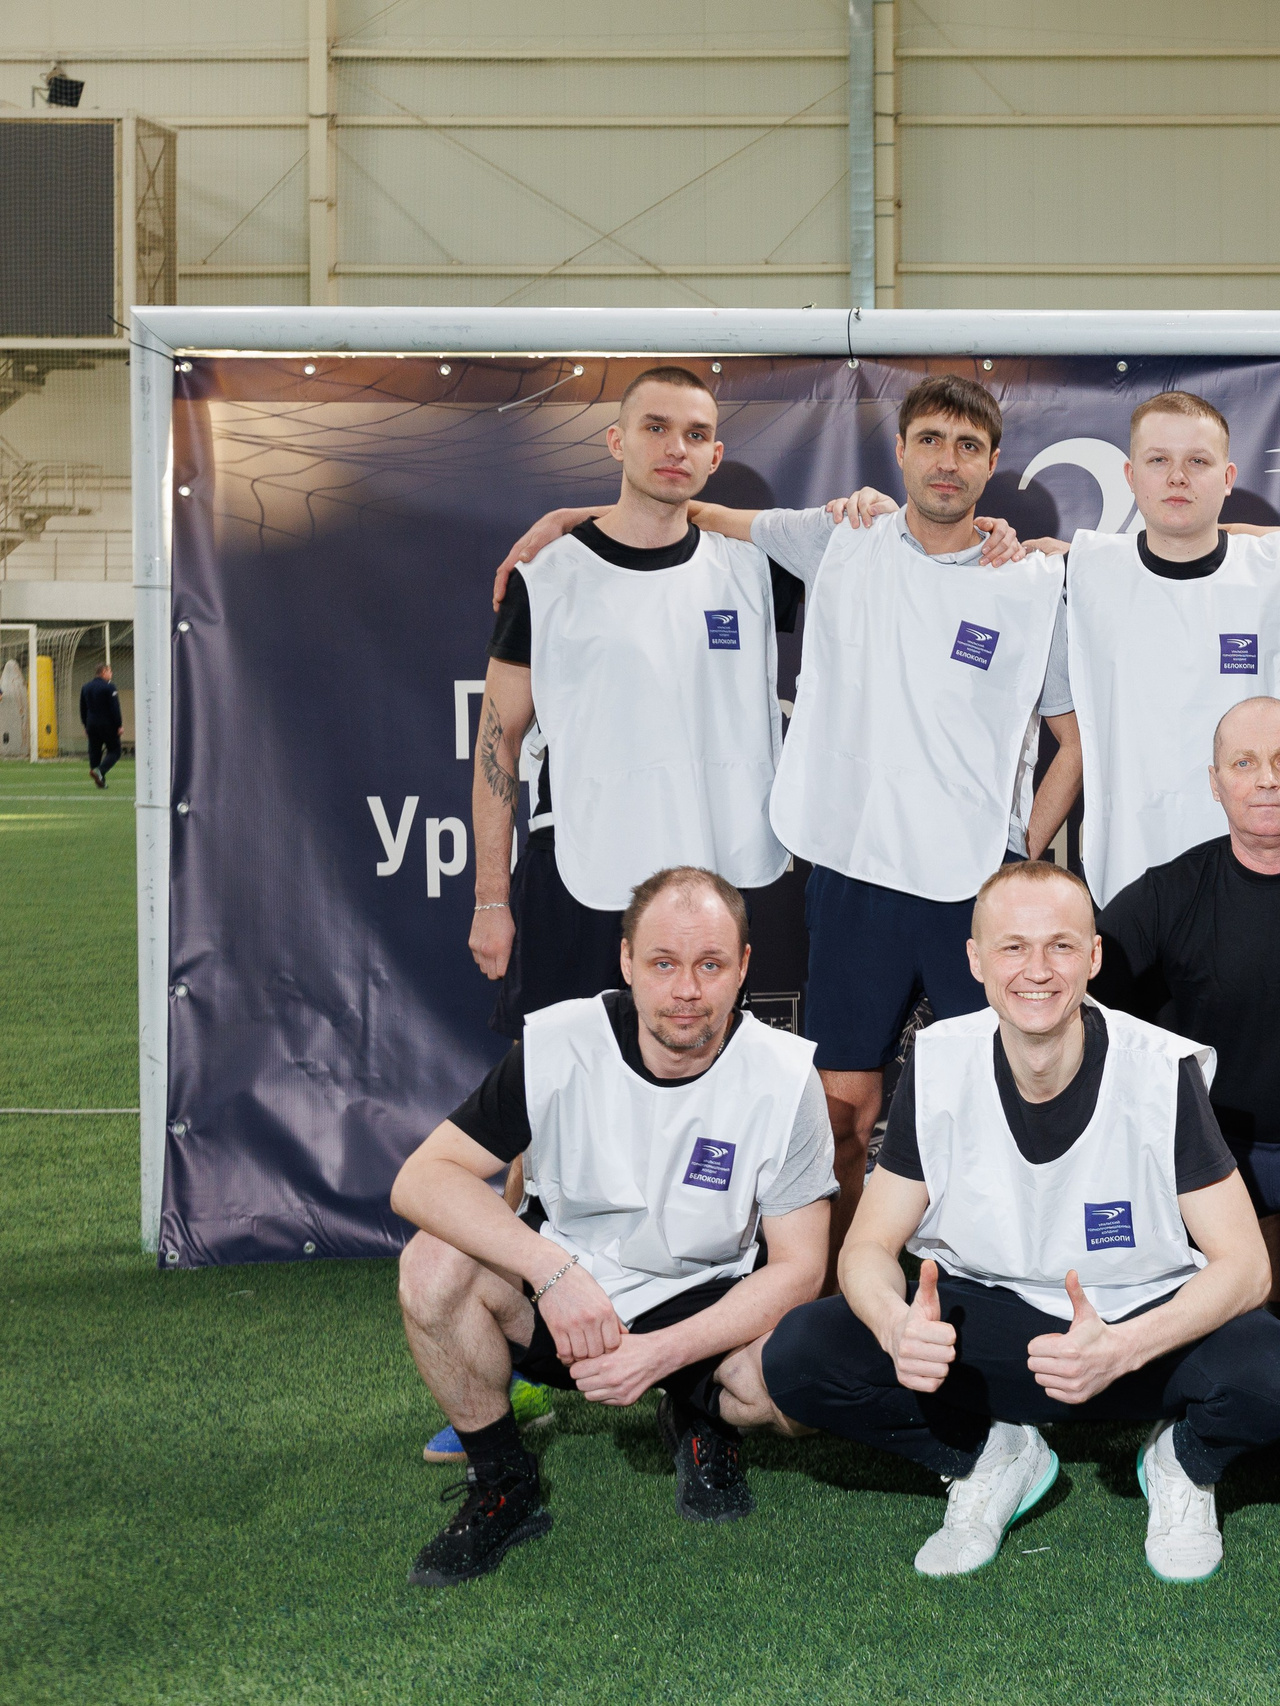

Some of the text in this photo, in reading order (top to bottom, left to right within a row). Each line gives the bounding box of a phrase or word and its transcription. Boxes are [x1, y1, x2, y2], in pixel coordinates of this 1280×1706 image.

[955, 649, 987, 665] БЕЛОКОПИ
[689, 1172, 726, 1185] БЕЛОКОПИ
[1090, 1235, 1130, 1245] БЕЛОКОПИ
